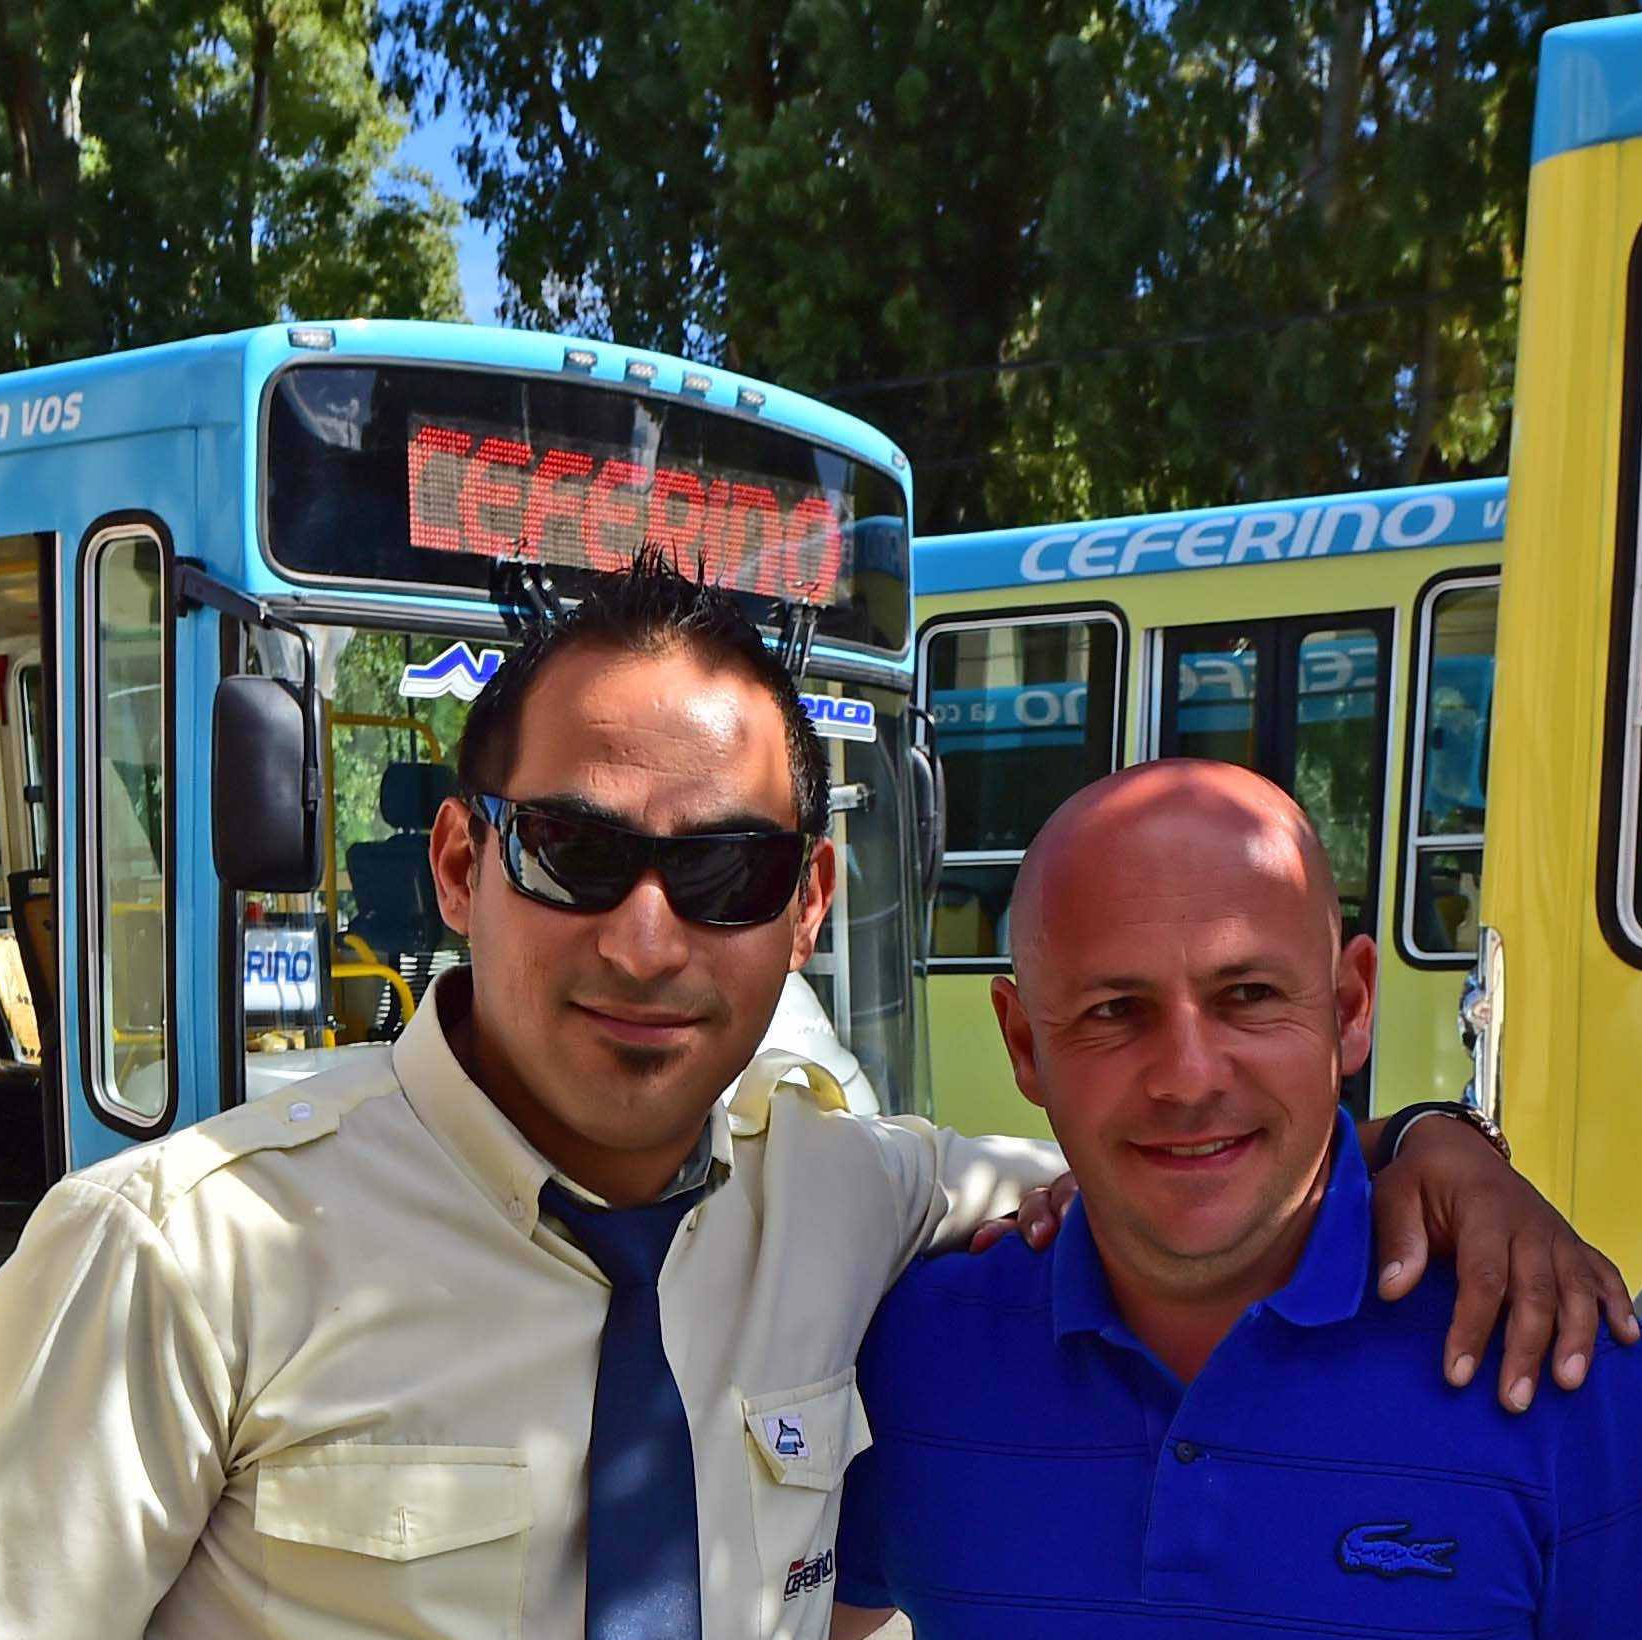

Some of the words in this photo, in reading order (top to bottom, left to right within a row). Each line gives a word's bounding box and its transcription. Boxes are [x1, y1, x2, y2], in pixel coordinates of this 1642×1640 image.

[21, 391, 83, 437] vos
[408, 425, 843, 605] CEFERINO
[1020, 494, 1456, 582] CEFERINO
